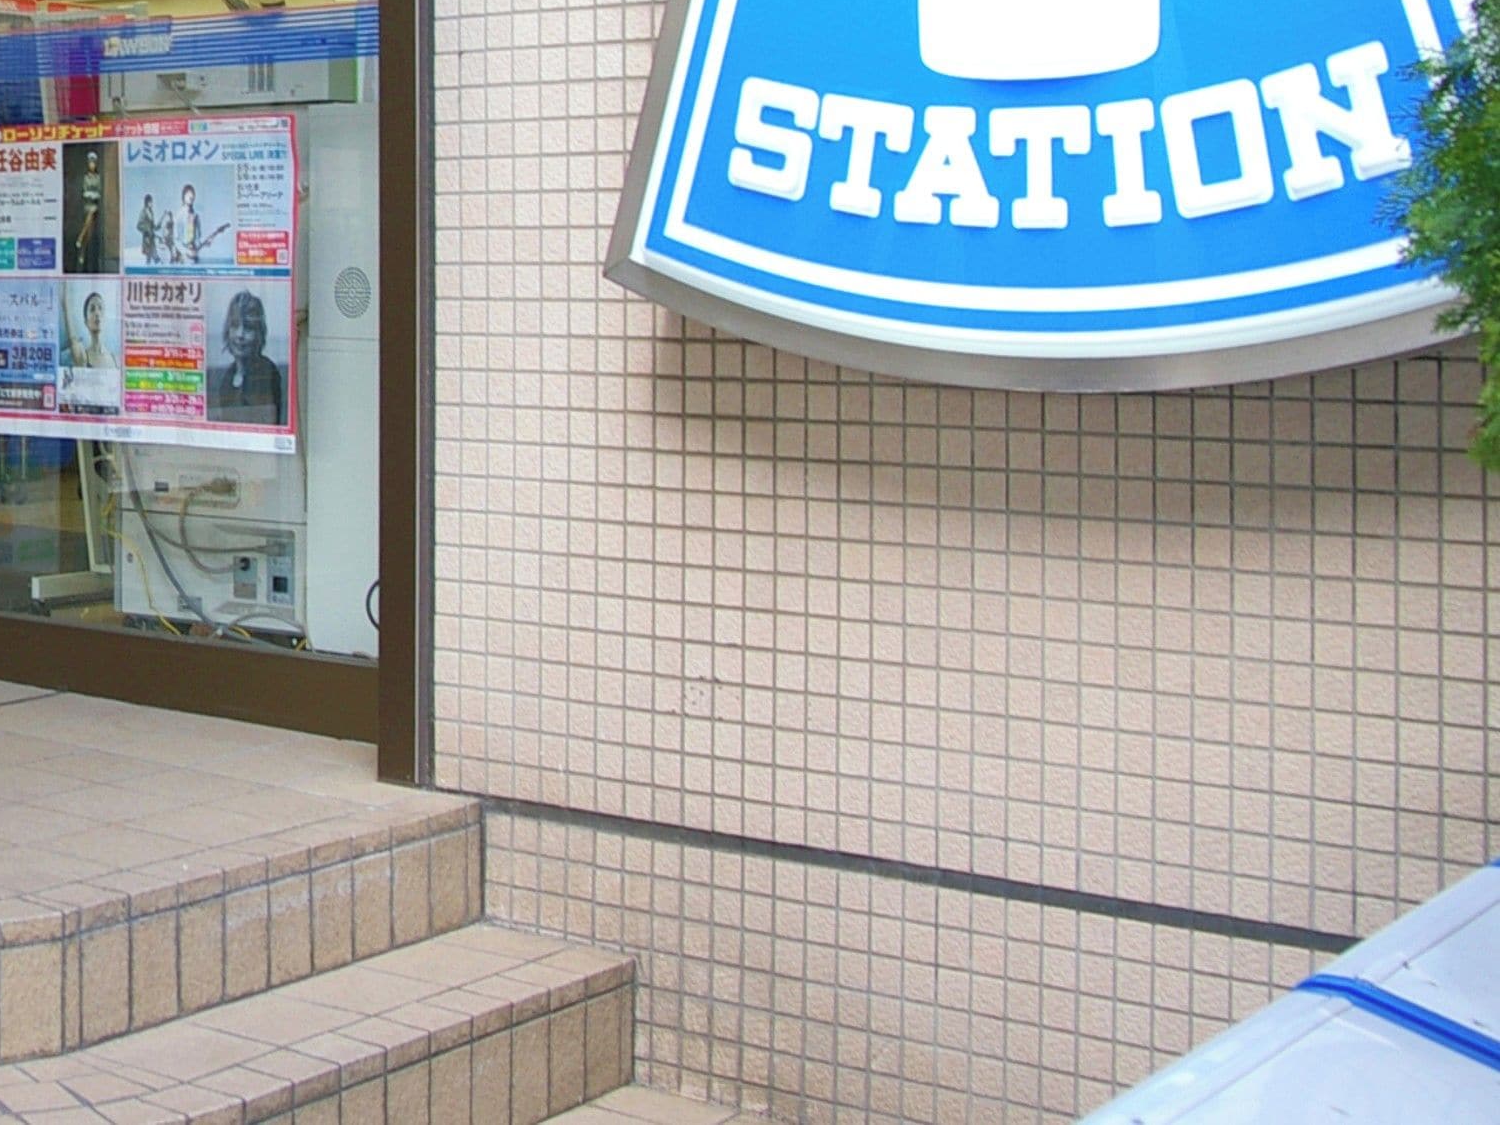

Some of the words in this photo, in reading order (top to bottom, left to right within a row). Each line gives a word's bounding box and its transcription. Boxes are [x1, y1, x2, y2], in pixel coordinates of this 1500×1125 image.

[103, 35, 172, 58] LAWSON
[3, 125, 112, 142] ローソンチケット
[728, 41, 1413, 230] STATION
[127, 139, 220, 163] レミオロメン
[127, 281, 201, 304] 川村カオリ
[11, 346, 53, 362] 3月20日
